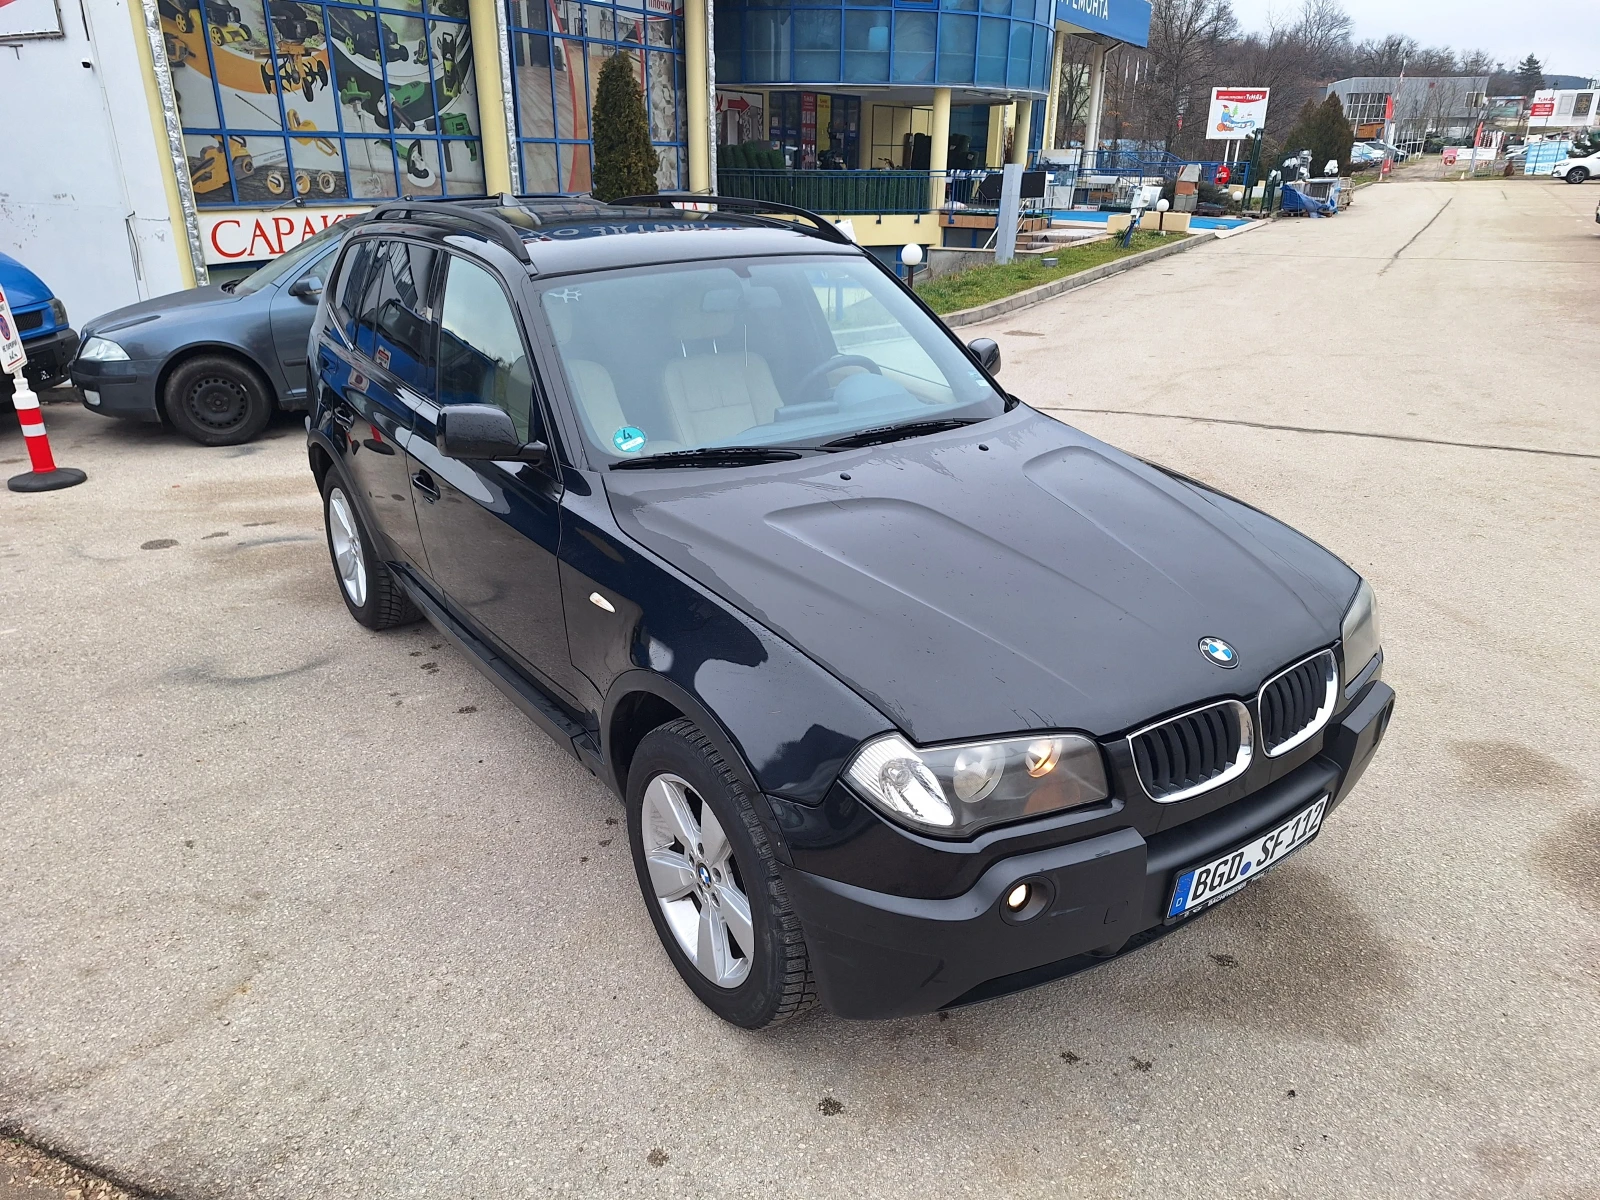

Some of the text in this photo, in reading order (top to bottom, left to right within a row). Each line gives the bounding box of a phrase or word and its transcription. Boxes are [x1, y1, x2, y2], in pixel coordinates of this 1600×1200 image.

[622, 429, 632, 440] 4
[1191, 851, 1244, 902] BGD
[1256, 825, 1290, 868] SF
[1285, 801, 1325, 850] 112
[1175, 897, 1183, 908] D
